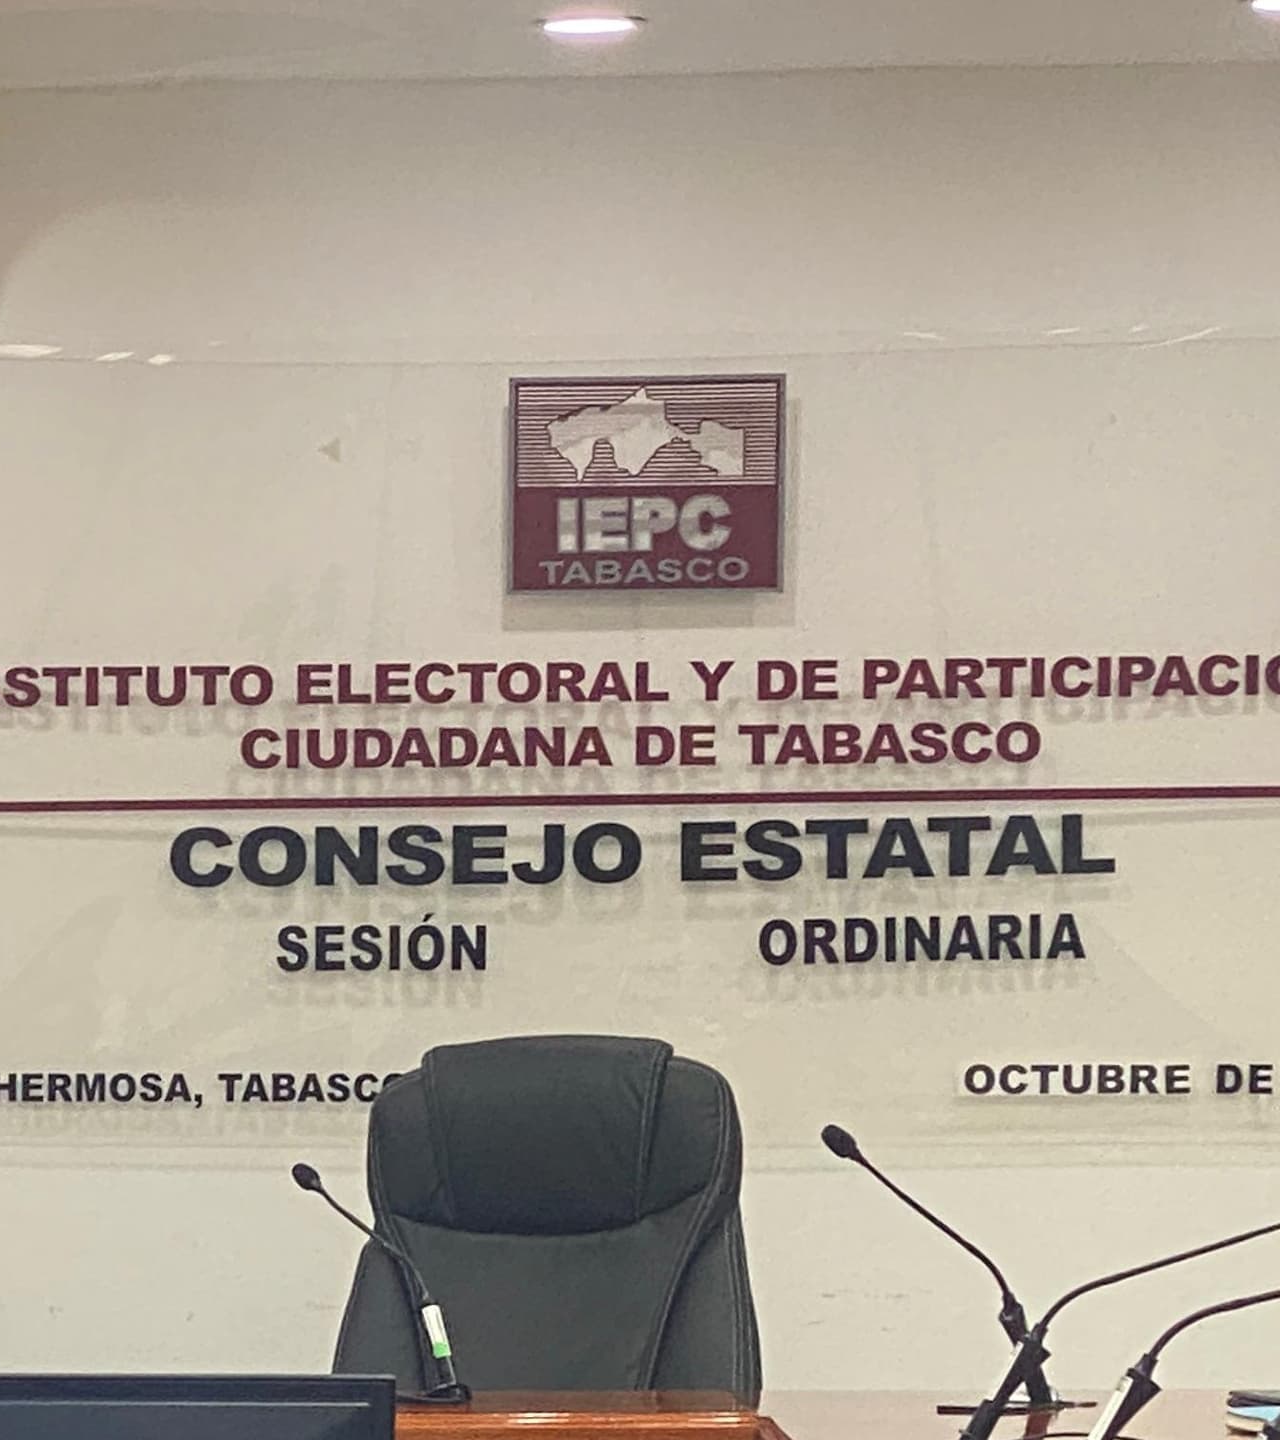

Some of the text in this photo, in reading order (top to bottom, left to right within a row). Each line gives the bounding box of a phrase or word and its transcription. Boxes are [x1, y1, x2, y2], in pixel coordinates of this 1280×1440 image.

[557, 494, 732, 554] IEPC
[538, 556, 750, 586] TABASCO
[296, 660, 670, 706] ELECTORAL
[689, 660, 736, 702] Y
[756, 659, 839, 701] DE
[240, 721, 1042, 770] CIUDADANA DE TABASCO
[169, 814, 1116, 888] CONSEJO ESTATAL
[275, 913, 488, 973] SESIÓN
[758, 913, 1086, 966] ORDINARIA
[963, 1063, 1275, 1096] OCTUBRE DE
